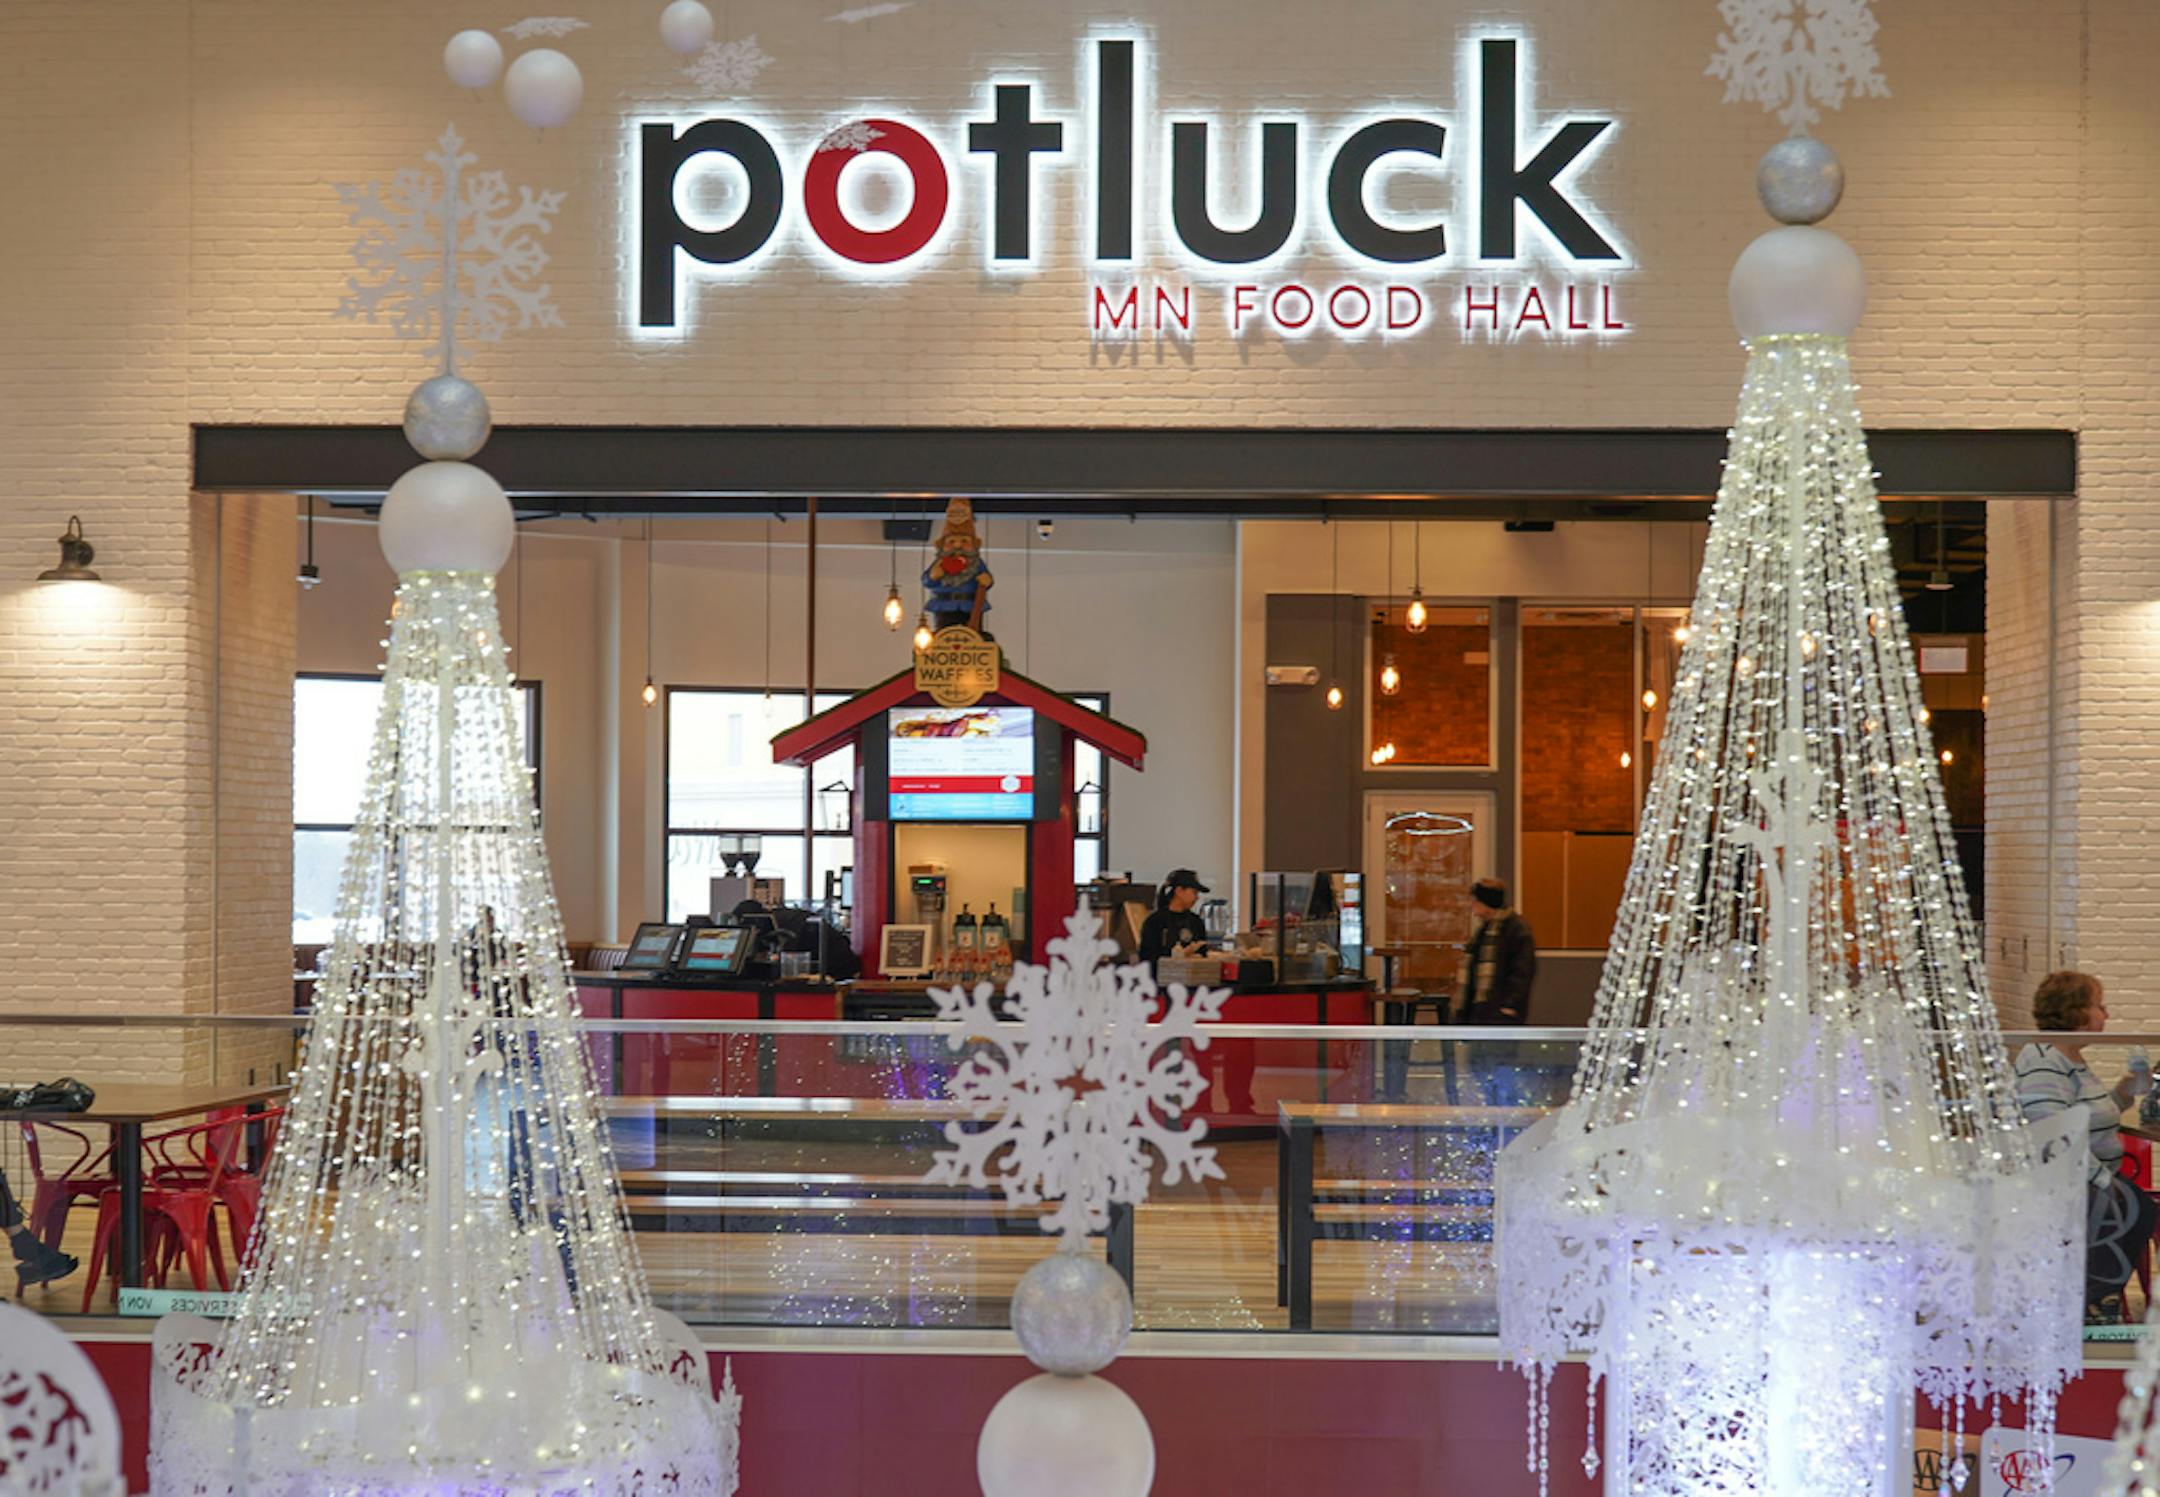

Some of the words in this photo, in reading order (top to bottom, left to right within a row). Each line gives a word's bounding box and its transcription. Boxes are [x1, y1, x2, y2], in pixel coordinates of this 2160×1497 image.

[639, 40, 1623, 327] potluck
[1094, 285, 1190, 330] MN
[1234, 285, 1422, 330] FOOD
[1466, 285, 1624, 330] HALL
[924, 652, 990, 666] NORDIC
[920, 668, 993, 682] WAFFES
